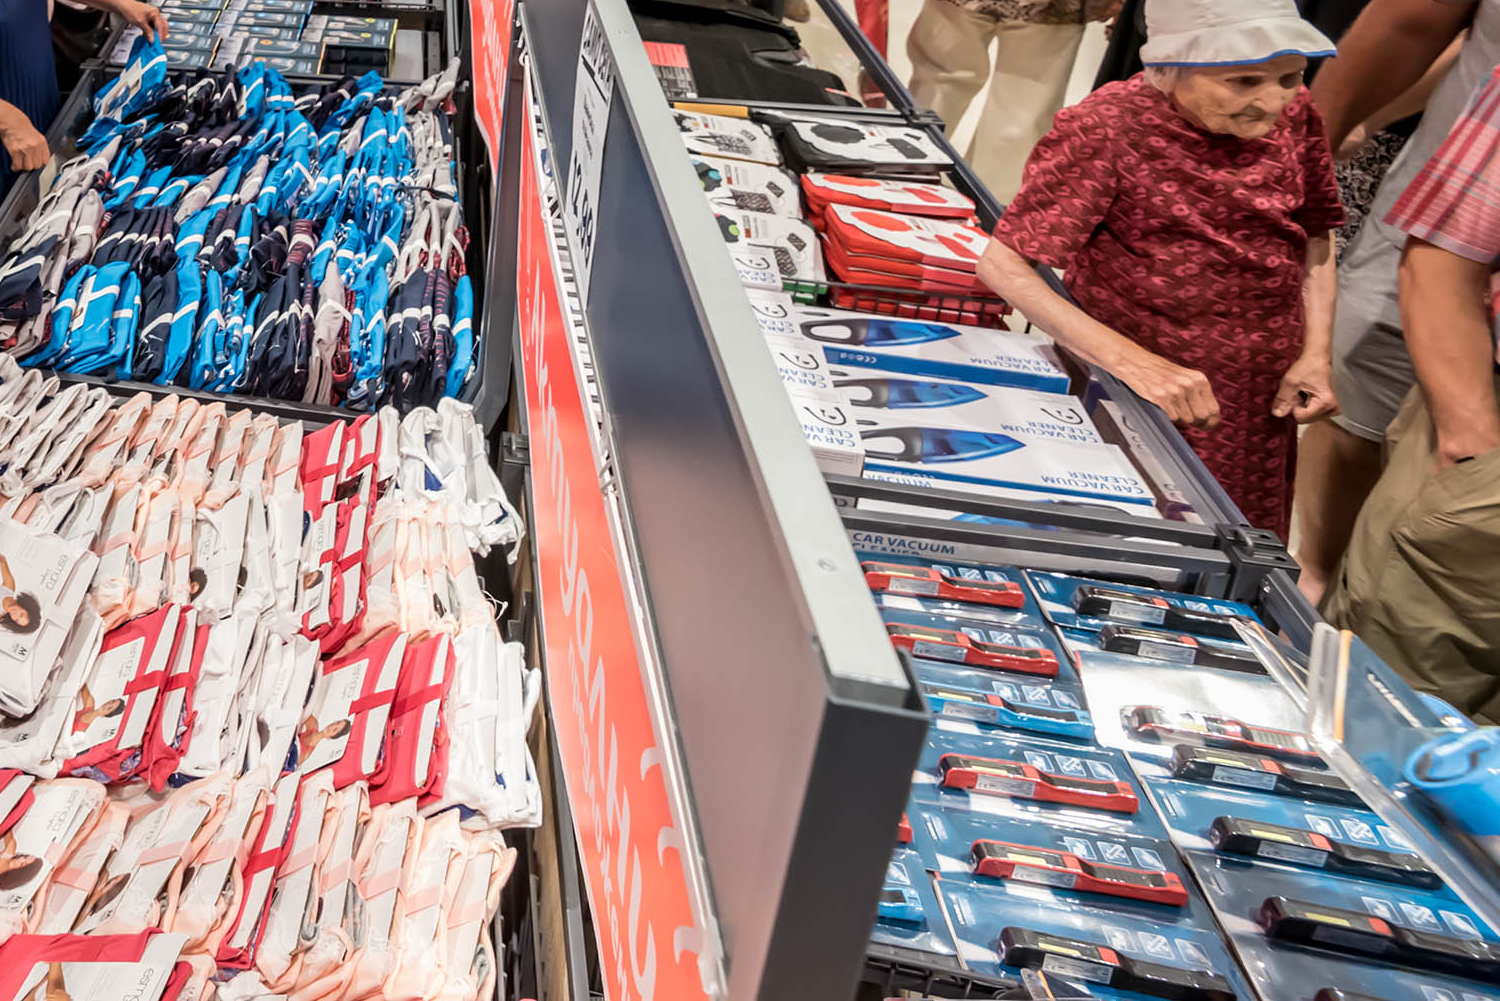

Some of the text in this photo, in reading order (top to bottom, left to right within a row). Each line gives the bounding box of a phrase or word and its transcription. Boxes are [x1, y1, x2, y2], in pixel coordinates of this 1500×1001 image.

[778, 367, 824, 381] CLEAN
[802, 423, 852, 438] CLEAN
[1000, 423, 1098, 443] CAR VACUUM
[1027, 420, 1092, 435] CLEANER
[824, 435, 855, 447] CAR
[1040, 475, 1144, 493] CAR VACUUM
[1067, 470, 1137, 485] CLEANER
[852, 532, 955, 555] CAR VACUUM
[44, 553, 70, 591] esmara
[17, 646, 28, 657] M
[50, 788, 80, 833] esmara
